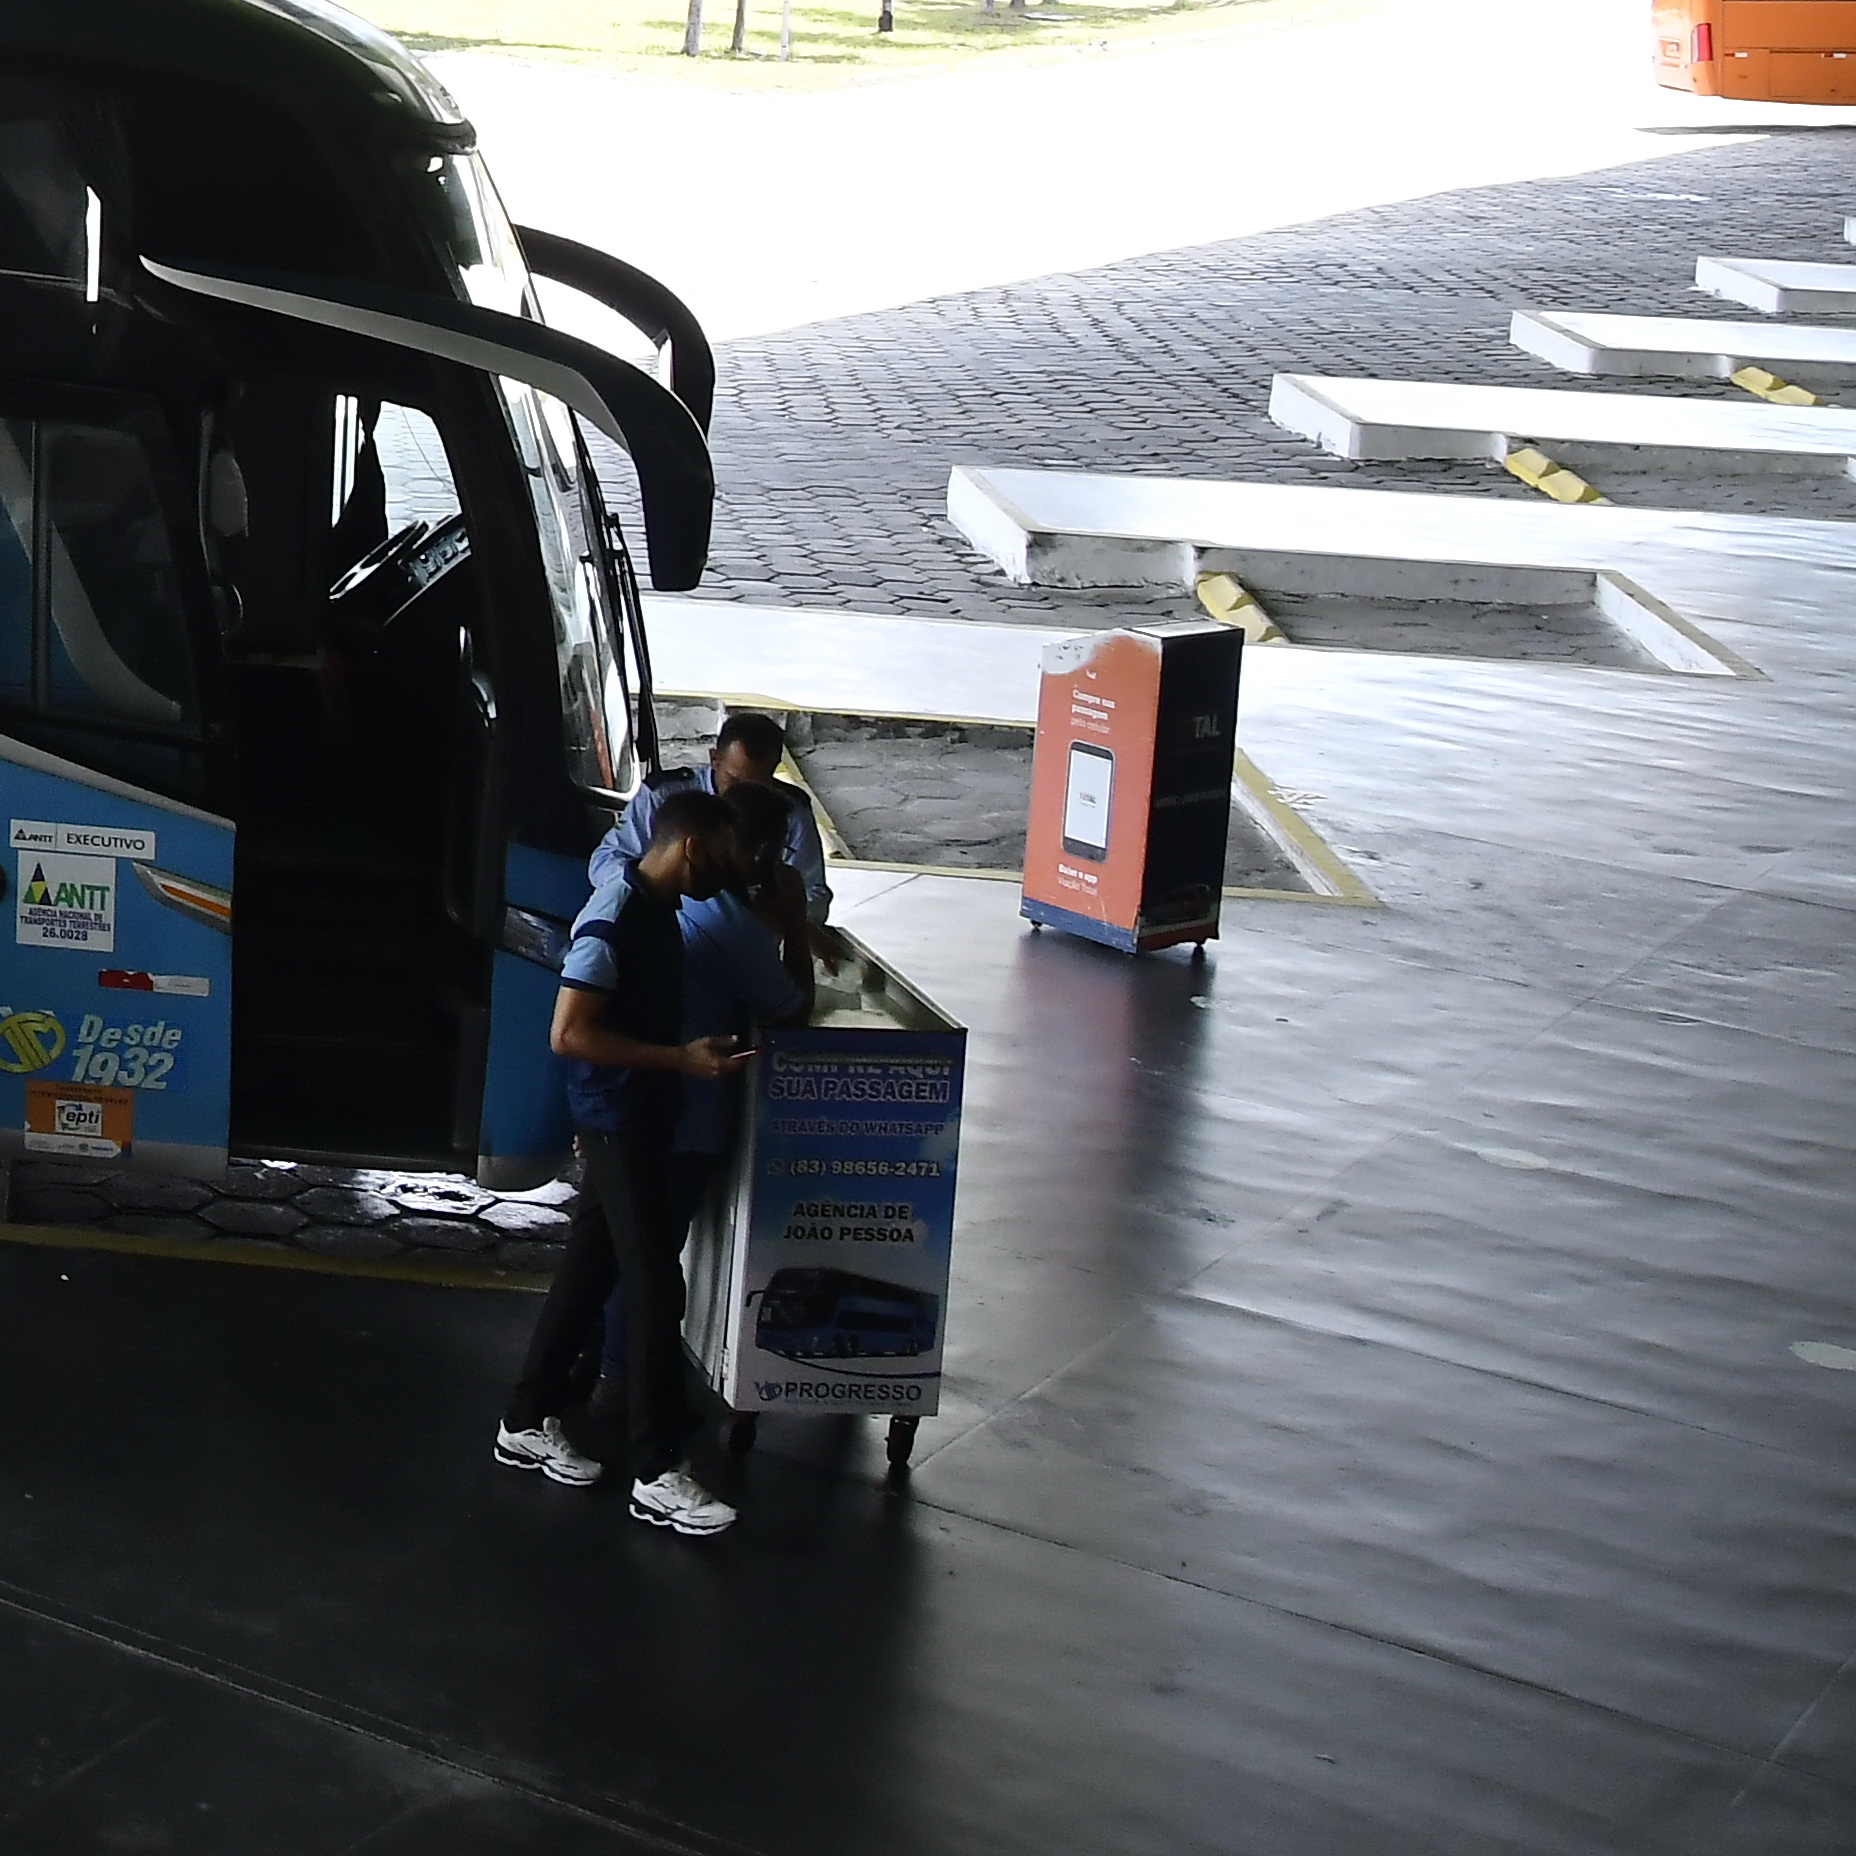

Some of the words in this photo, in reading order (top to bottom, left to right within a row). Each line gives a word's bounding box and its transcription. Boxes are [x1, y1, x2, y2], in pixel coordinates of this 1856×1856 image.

[27, 833, 54, 843] ANTT
[65, 831, 146, 852] EXECUTIVO
[53, 881, 110, 912] ANTT
[77, 1013, 183, 1050] Desde
[71, 1046, 176, 1090] 1932
[769, 1076, 818, 1101] SUA
[822, 1078, 950, 1104] PASSAGEM
[65, 1110, 101, 1126] epti
[862, 1120, 945, 1137] WHATSAPP
[790, 1159, 826, 1178] (83)
[792, 1197, 878, 1220] AGÊNCIA
[883, 1203, 910, 1221] DE
[782, 1221, 834, 1242] JOÃO
[838, 1226, 915, 1243] PESSOA
[784, 1380, 923, 1402] PROGRESSO
